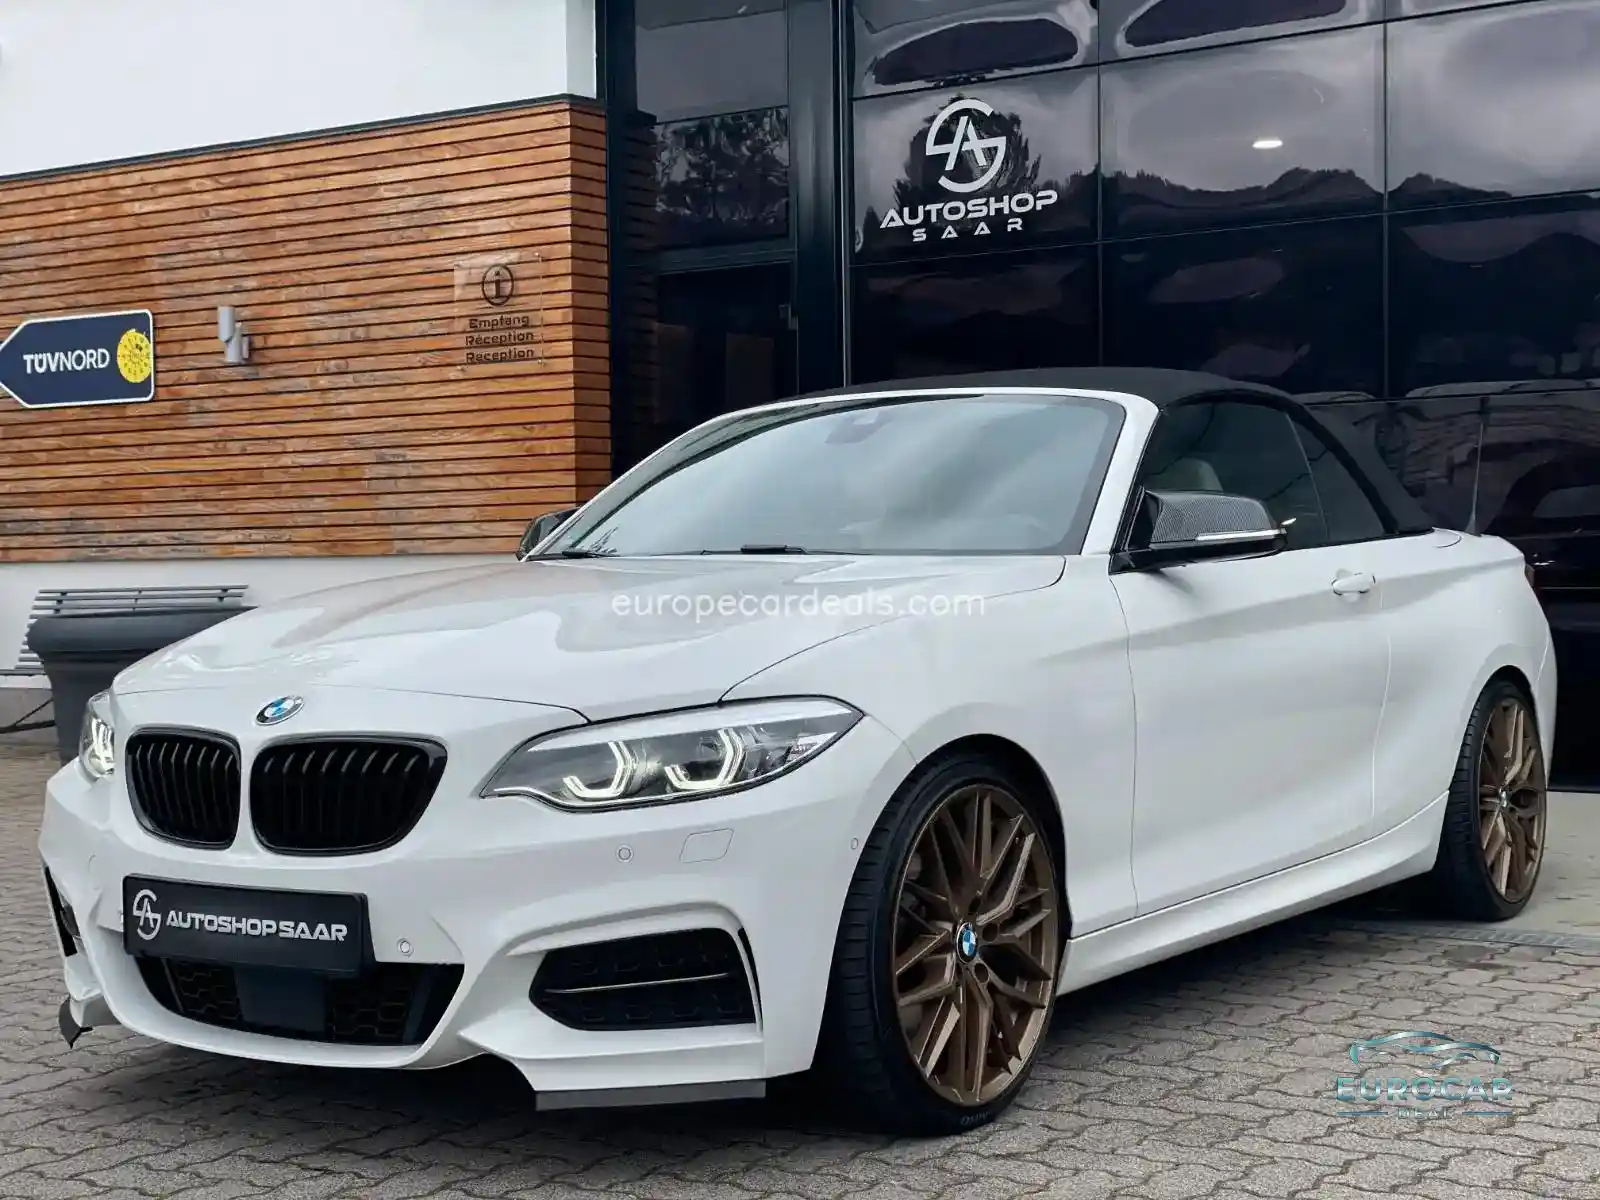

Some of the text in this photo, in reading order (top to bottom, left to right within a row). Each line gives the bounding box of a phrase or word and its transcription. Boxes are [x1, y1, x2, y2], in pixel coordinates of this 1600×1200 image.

[880, 190, 1058, 229] AUTOSHOP
[912, 217, 1023, 242] SAAR
[469, 314, 529, 329] Empfang
[465, 329, 534, 346] Réception
[466, 347, 535, 364] Reception
